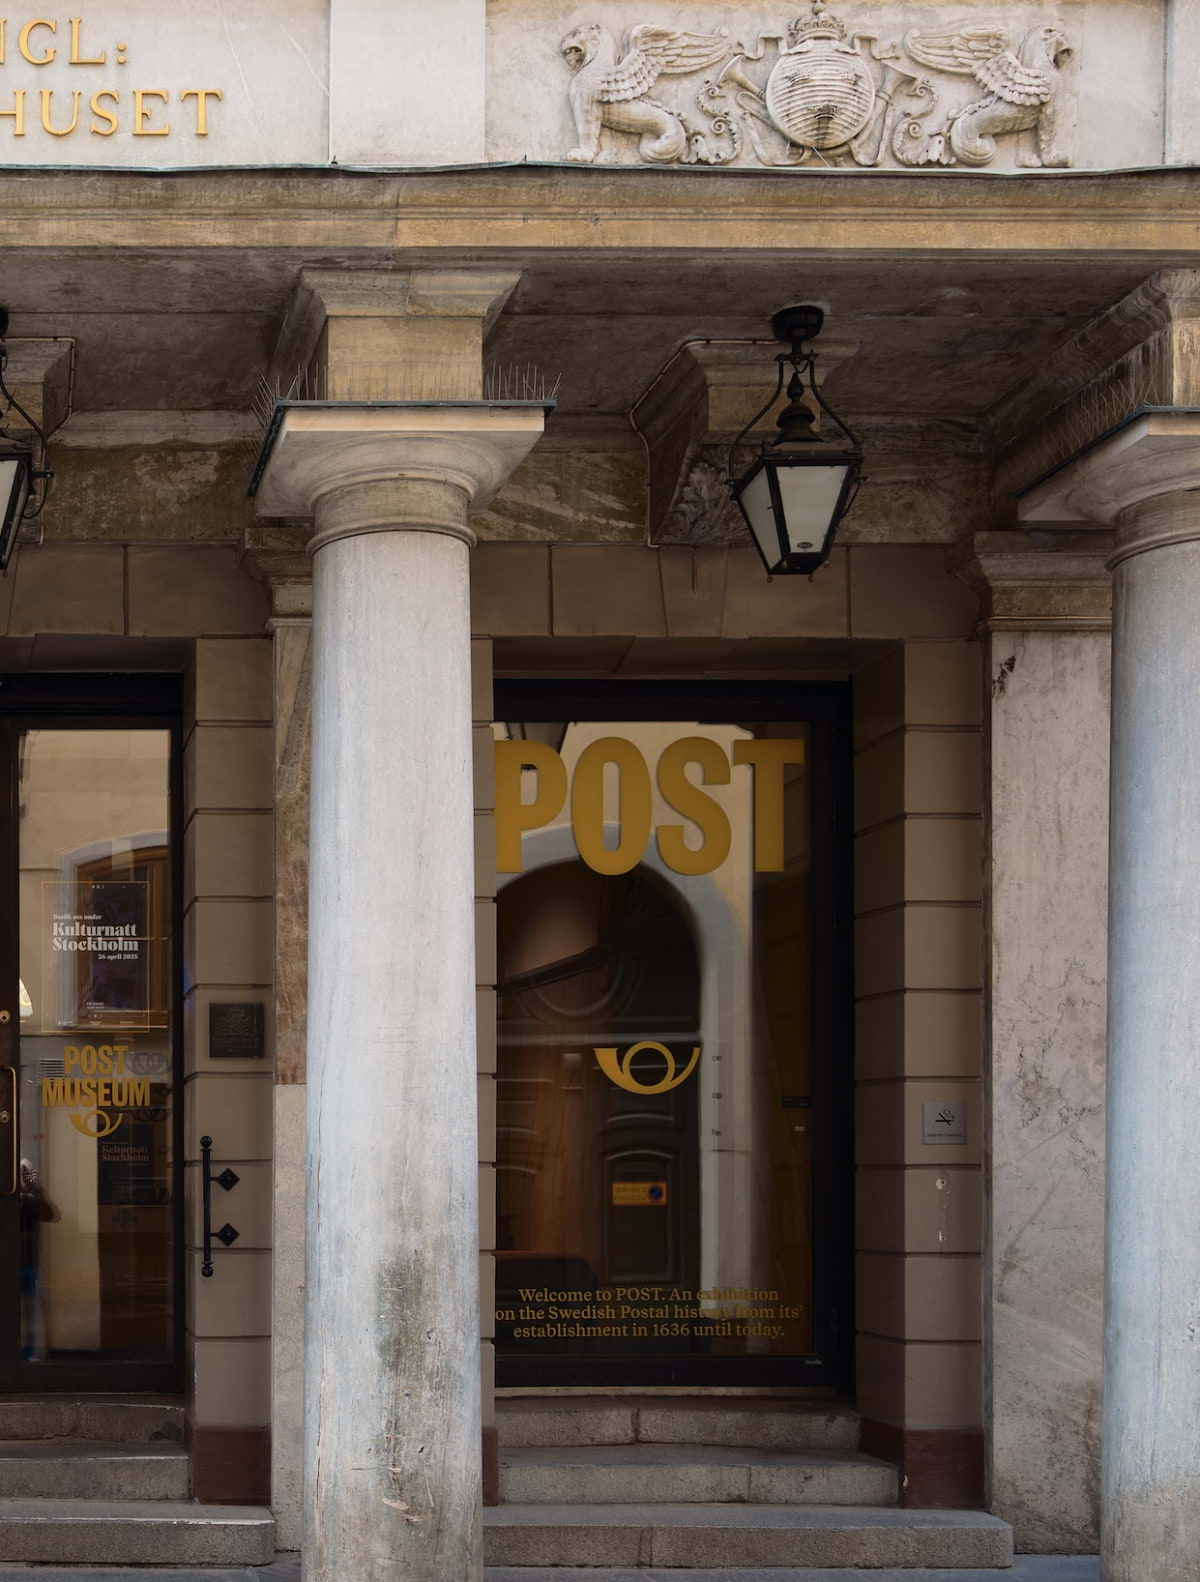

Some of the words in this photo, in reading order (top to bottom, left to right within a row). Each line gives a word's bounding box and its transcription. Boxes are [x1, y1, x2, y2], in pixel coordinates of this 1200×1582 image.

[494, 736, 806, 877] POST
[52, 921, 137, 937] Kulturnatt
[52, 936, 139, 952] Stockholm
[107, 953, 122, 961] april
[63, 1045, 129, 1075] POST
[41, 1077, 151, 1107] MUSEUM
[518, 1287, 593, 1302] Welcome
[595, 1290, 612, 1301] to
[615, 1287, 666, 1301] POST.
[669, 1287, 693, 1301] An
[495, 1309, 516, 1321] on
[519, 1305, 545, 1320] the
[548, 1305, 617, 1320] Swedish
[620, 1304, 669, 1319] Postal
[513, 1323, 629, 1338] establishment
[632, 1322, 648, 1337] in
[651, 1322, 690, 1337] 1636
[694, 1321, 732, 1337] until
[735, 1321, 786, 1339] today.
